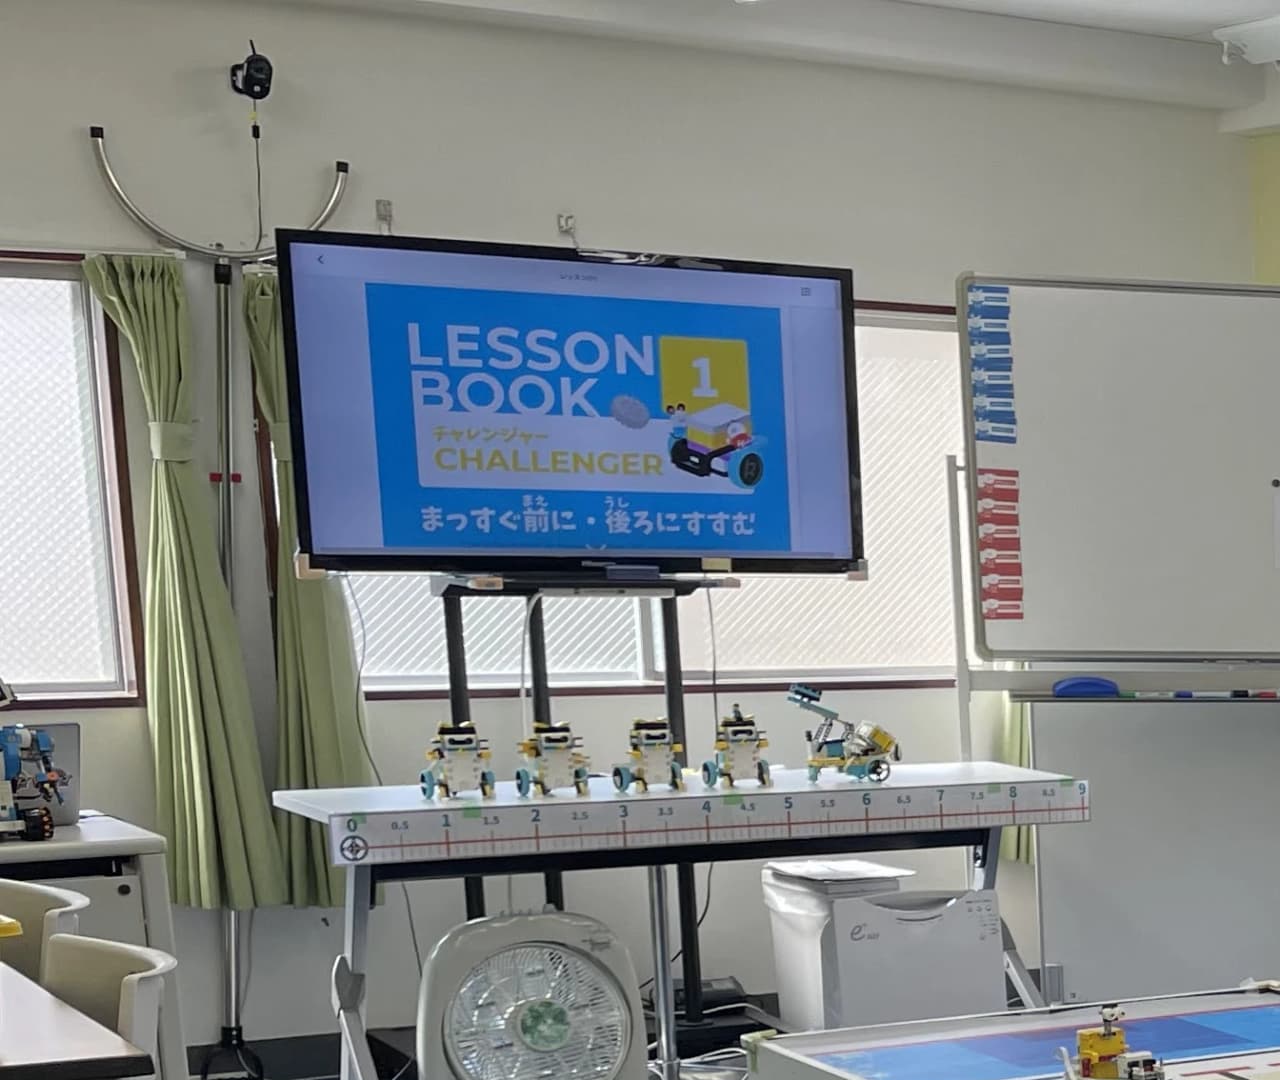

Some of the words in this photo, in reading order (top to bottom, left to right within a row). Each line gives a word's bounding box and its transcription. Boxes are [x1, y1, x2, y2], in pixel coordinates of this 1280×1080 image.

[408, 322, 655, 376] LESSON
[411, 371, 600, 418] BOOK
[691, 357, 719, 399] 1
[432, 427, 548, 444] チャレンジャー
[434, 447, 664, 477] CHALLENGER
[421, 506, 756, 535] まっすぐ前に・後ろにすすむ
[346, 818, 358, 832] 0
[391, 821, 409, 830] 0.5
[442, 815, 451, 827] 1
[483, 816, 500, 825] 1.5
[531, 809, 541, 822] 2
[619, 805, 629, 818] 3
[702, 800, 712, 813] 4
[740, 802, 756, 811] 4.5
[784, 797, 793, 810] 5
[820, 799, 835, 808] 5.5
[862, 792, 872, 806] 6
[936, 789, 945, 802] 7
[970, 792, 984, 800] 7.5
[1009, 786, 1018, 798] 8
[1078, 783, 1087, 795] 9
